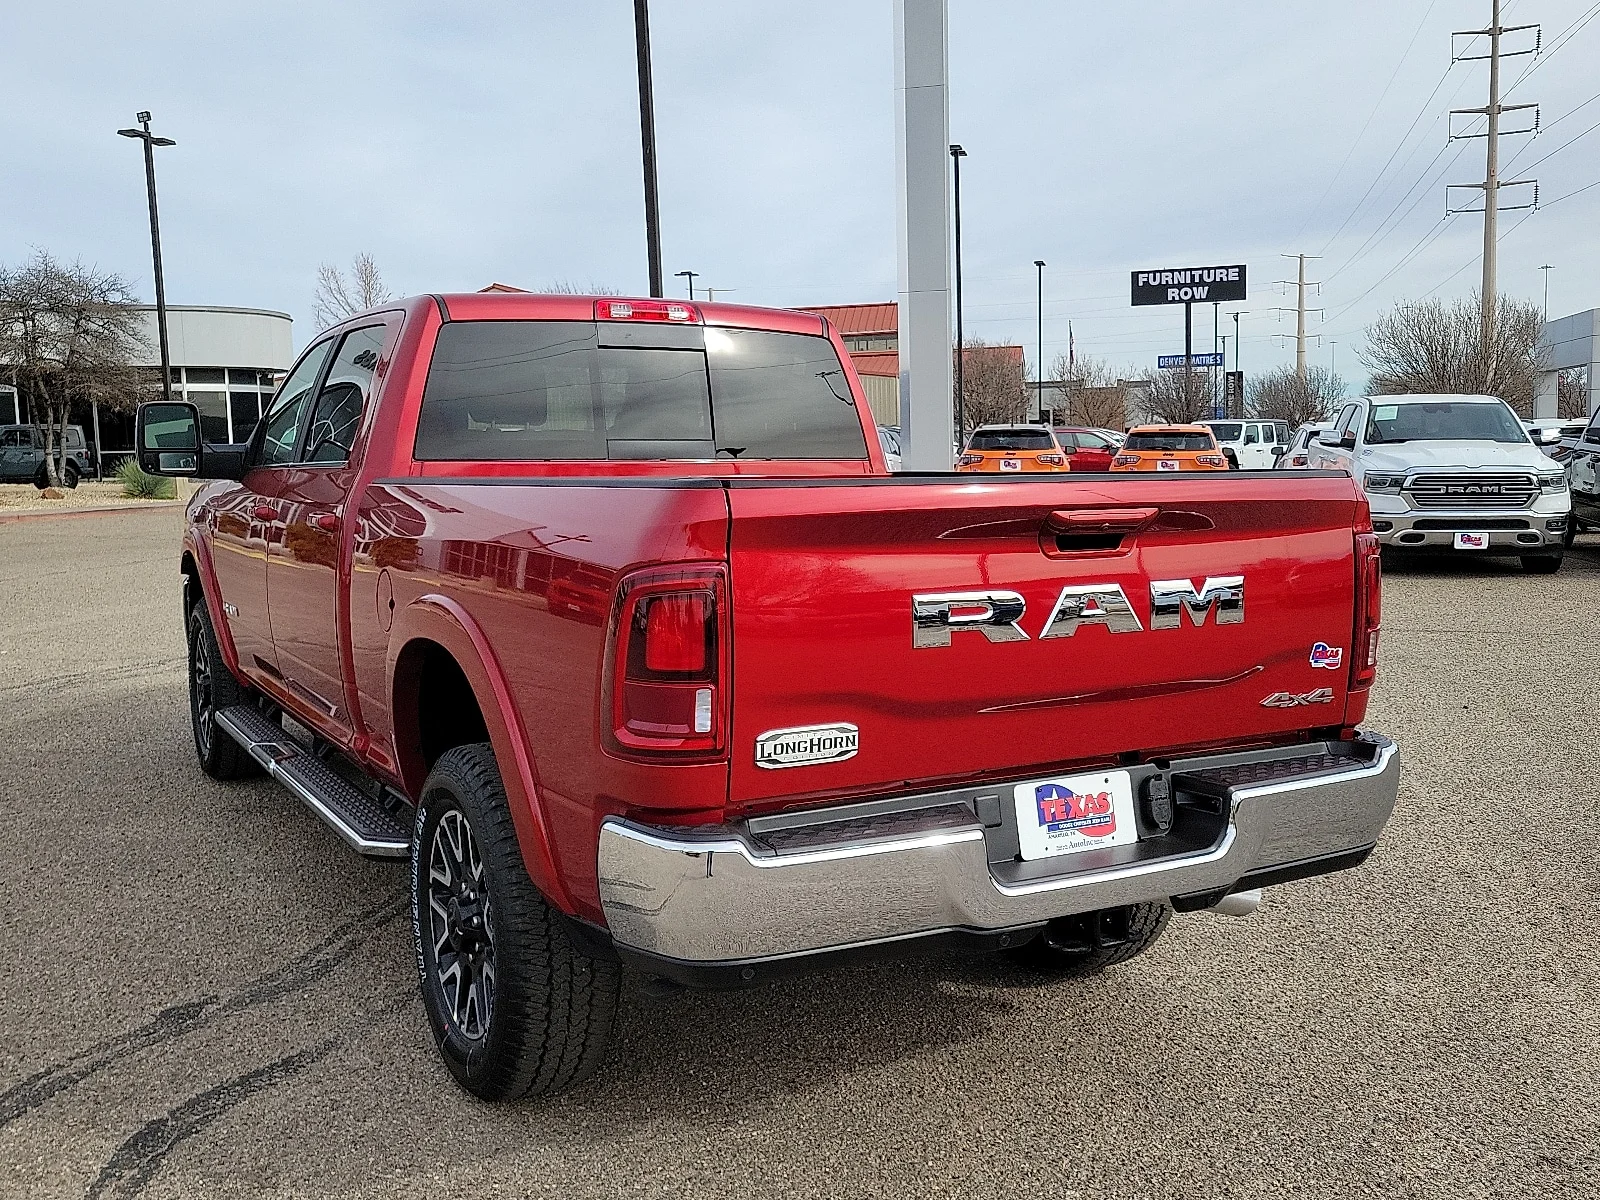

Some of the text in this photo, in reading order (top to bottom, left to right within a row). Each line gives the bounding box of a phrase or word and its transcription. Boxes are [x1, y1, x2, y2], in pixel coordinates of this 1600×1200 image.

[1138, 268, 1240, 287] FURNITURE
[1167, 286, 1209, 301] ROW
[1447, 485, 1499, 493] RAM
[911, 575, 1245, 649] RAM
[1041, 791, 1110, 822] TEXAS
